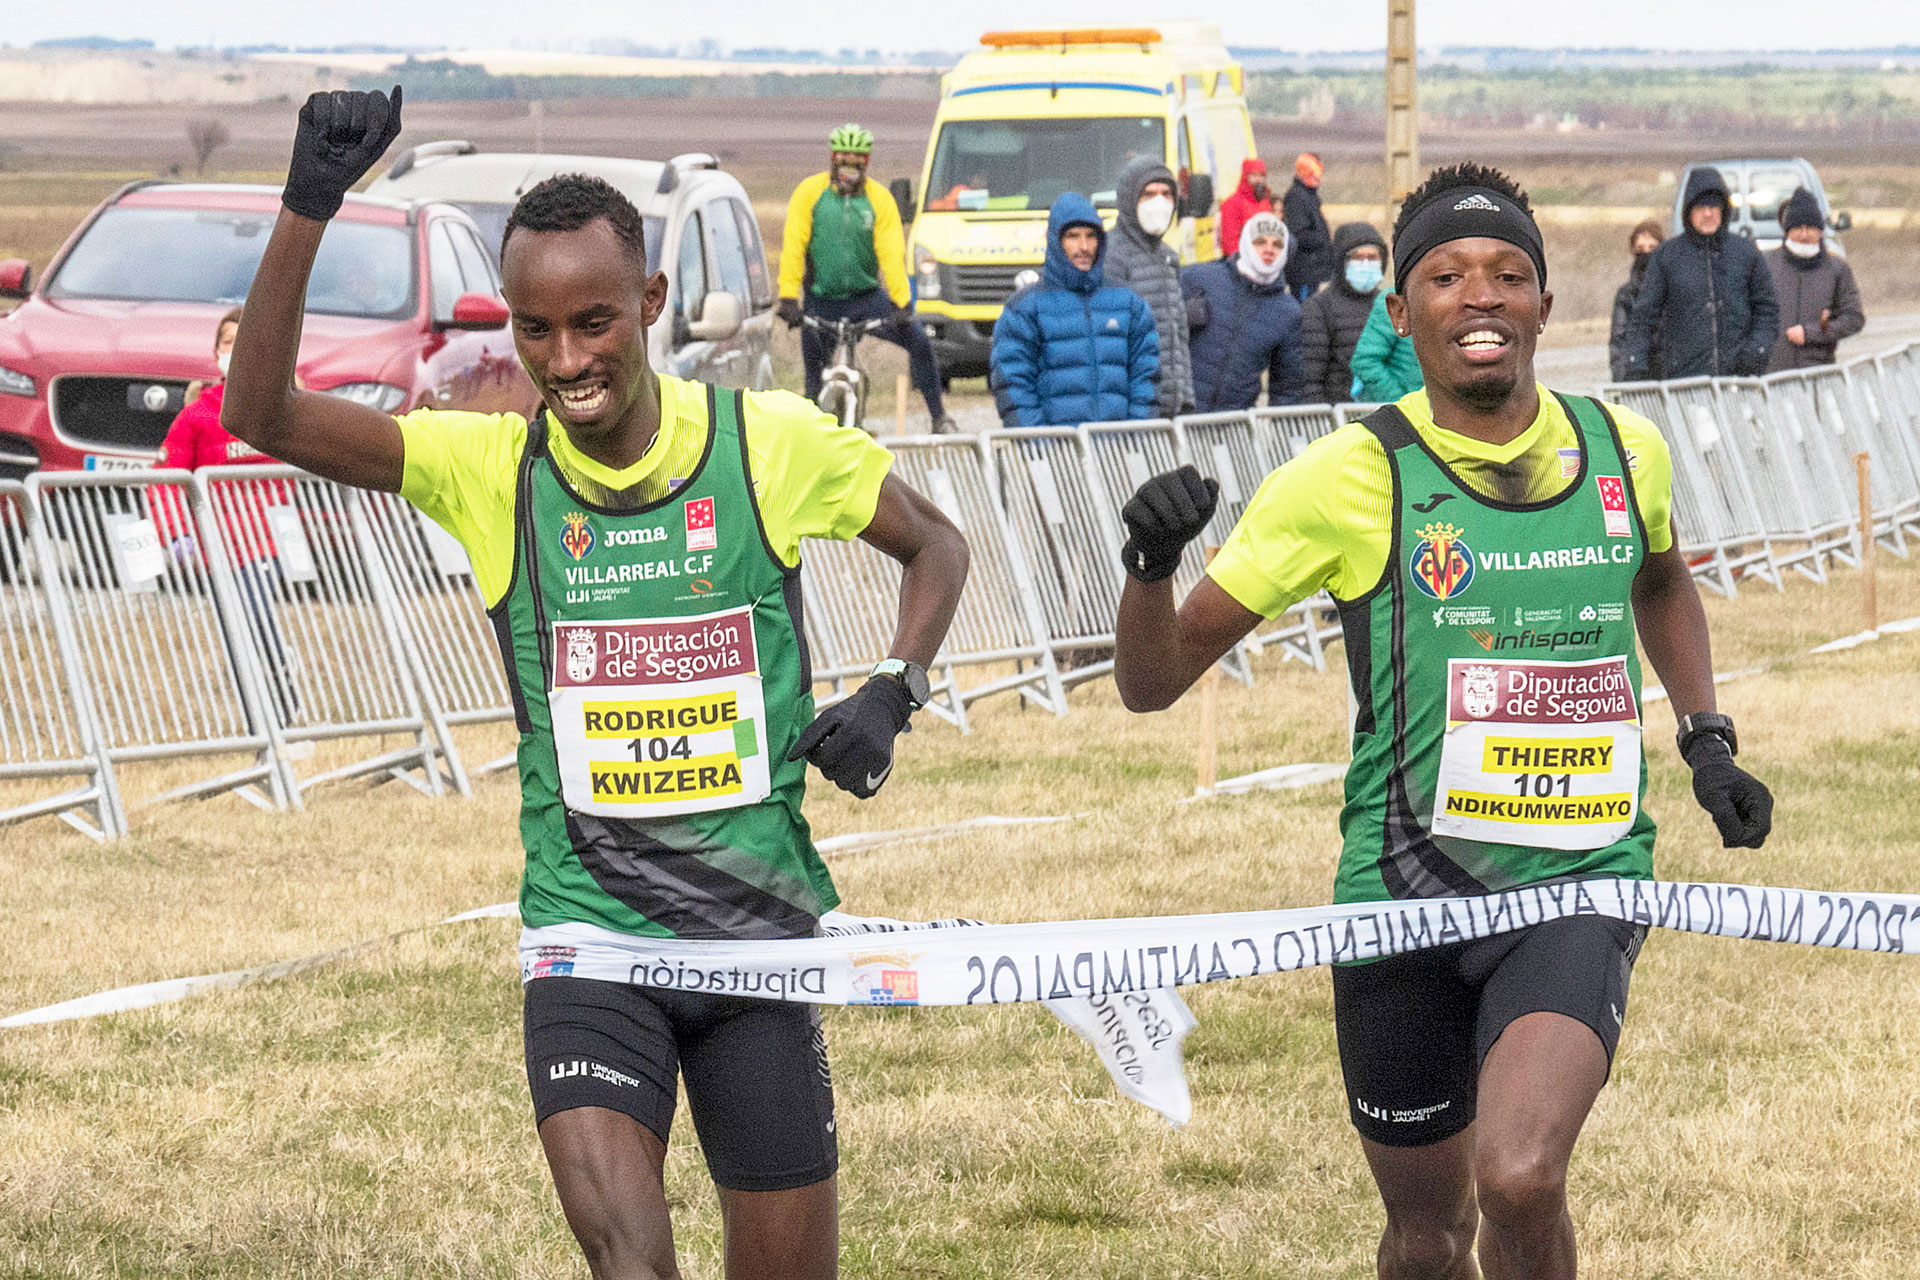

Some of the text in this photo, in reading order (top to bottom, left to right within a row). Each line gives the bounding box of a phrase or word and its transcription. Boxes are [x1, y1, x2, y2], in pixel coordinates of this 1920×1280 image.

[1453, 202, 1501, 212] adidas
[1478, 547, 1609, 571] VILLARREAL
[565, 560, 680, 585] VILLARREAL
[566, 589, 590, 604] UJI
[1445, 610, 1491, 618] COMUNITAT
[1448, 616, 1496, 626] DE L'ESPORT
[604, 621, 739, 659] Diputación
[1494, 626, 1603, 652] infisport
[605, 648, 741, 681] de Segovia
[1507, 668, 1626, 695] Diputación
[585, 700, 738, 732] RODRIGUE
[1506, 692, 1627, 722] de Segovia
[626, 735, 692, 763] 104
[1492, 745, 1613, 767] THIERRY
[591, 763, 742, 795] KWIZERA
[1514, 773, 1571, 798] 101
[1446, 795, 1631, 819] NDIKUMWENAYO
[549, 1060, 588, 1081] UJI
[591, 1062, 640, 1088] UNIVERSITAT
[1357, 1097, 1388, 1121] UJI
[1391, 1100, 1451, 1117] UNIVERSITAT
[1392, 1114, 1425, 1123] JAUME
